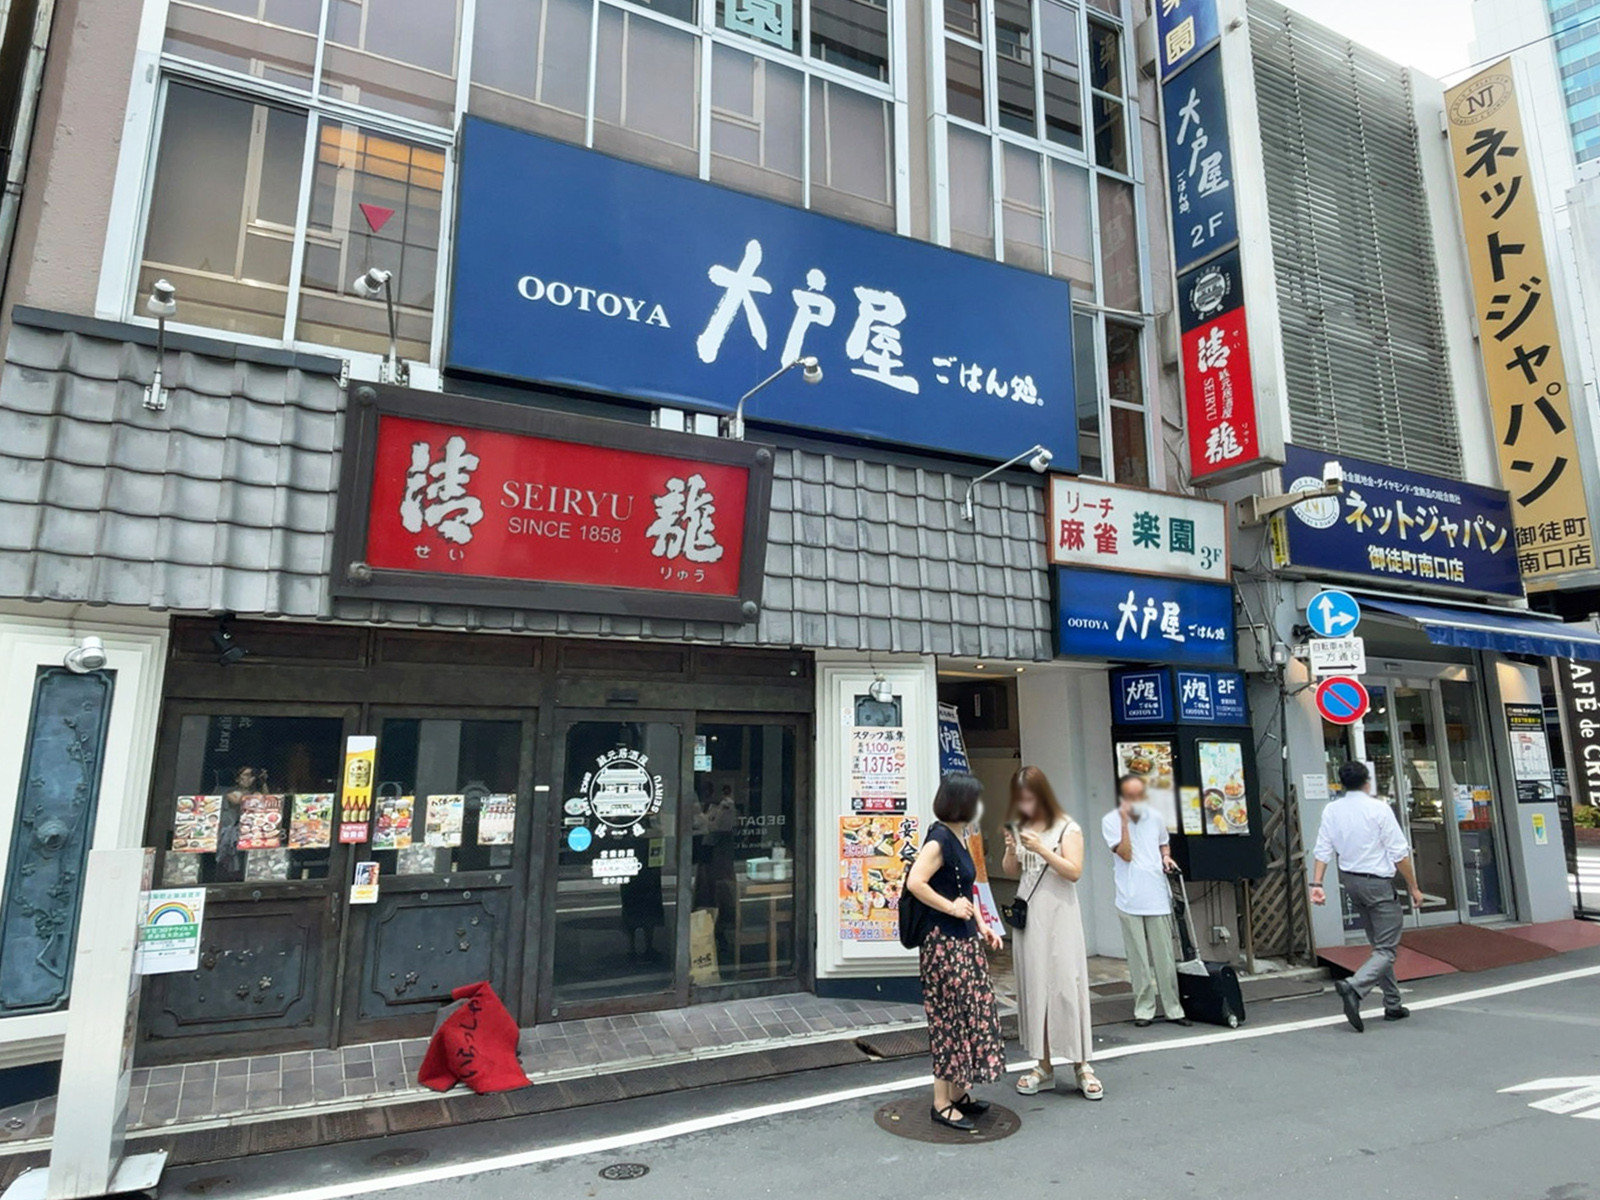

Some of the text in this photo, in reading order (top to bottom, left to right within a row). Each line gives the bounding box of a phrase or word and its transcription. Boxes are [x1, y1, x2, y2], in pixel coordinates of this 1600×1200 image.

[1466, 84, 1494, 116] NJ
[1176, 88, 1230, 199] 大戸屋
[1190, 211, 1224, 249] 2F
[517, 275, 671, 328] OOTOYA
[696, 238, 920, 394] 大戸屋
[1463, 127, 1568, 508] ネットジャパン
[1203, 377, 1218, 421] SEIRYU
[500, 480, 635, 522] SEIRYU
[645, 473, 725, 564] 龍
[1067, 491, 1115, 519] リーチ
[1344, 489, 1508, 555] ネットジャパン
[507, 517, 623, 545] SINCE 1858
[1059, 511, 1223, 571] 麻雀 楽園 3F
[1515, 516, 1588, 548] 御徒町
[1367, 544, 1465, 583] 御徒町南口店
[1518, 544, 1592, 575] 南口店
[1067, 617, 1110, 631] OOTOYA
[1115, 589, 1186, 643] 大戸屋
[1126, 679, 1158, 706] 大戸屋
[1182, 678, 1210, 704] 大戸屋
[1217, 679, 1236, 695] 2F
[1569, 657, 1600, 714] AFÉ
[853, 730, 906, 741] スタッフ募集
[1579, 718, 1600, 739] de
[651, 774, 664, 814] SEIRYU
